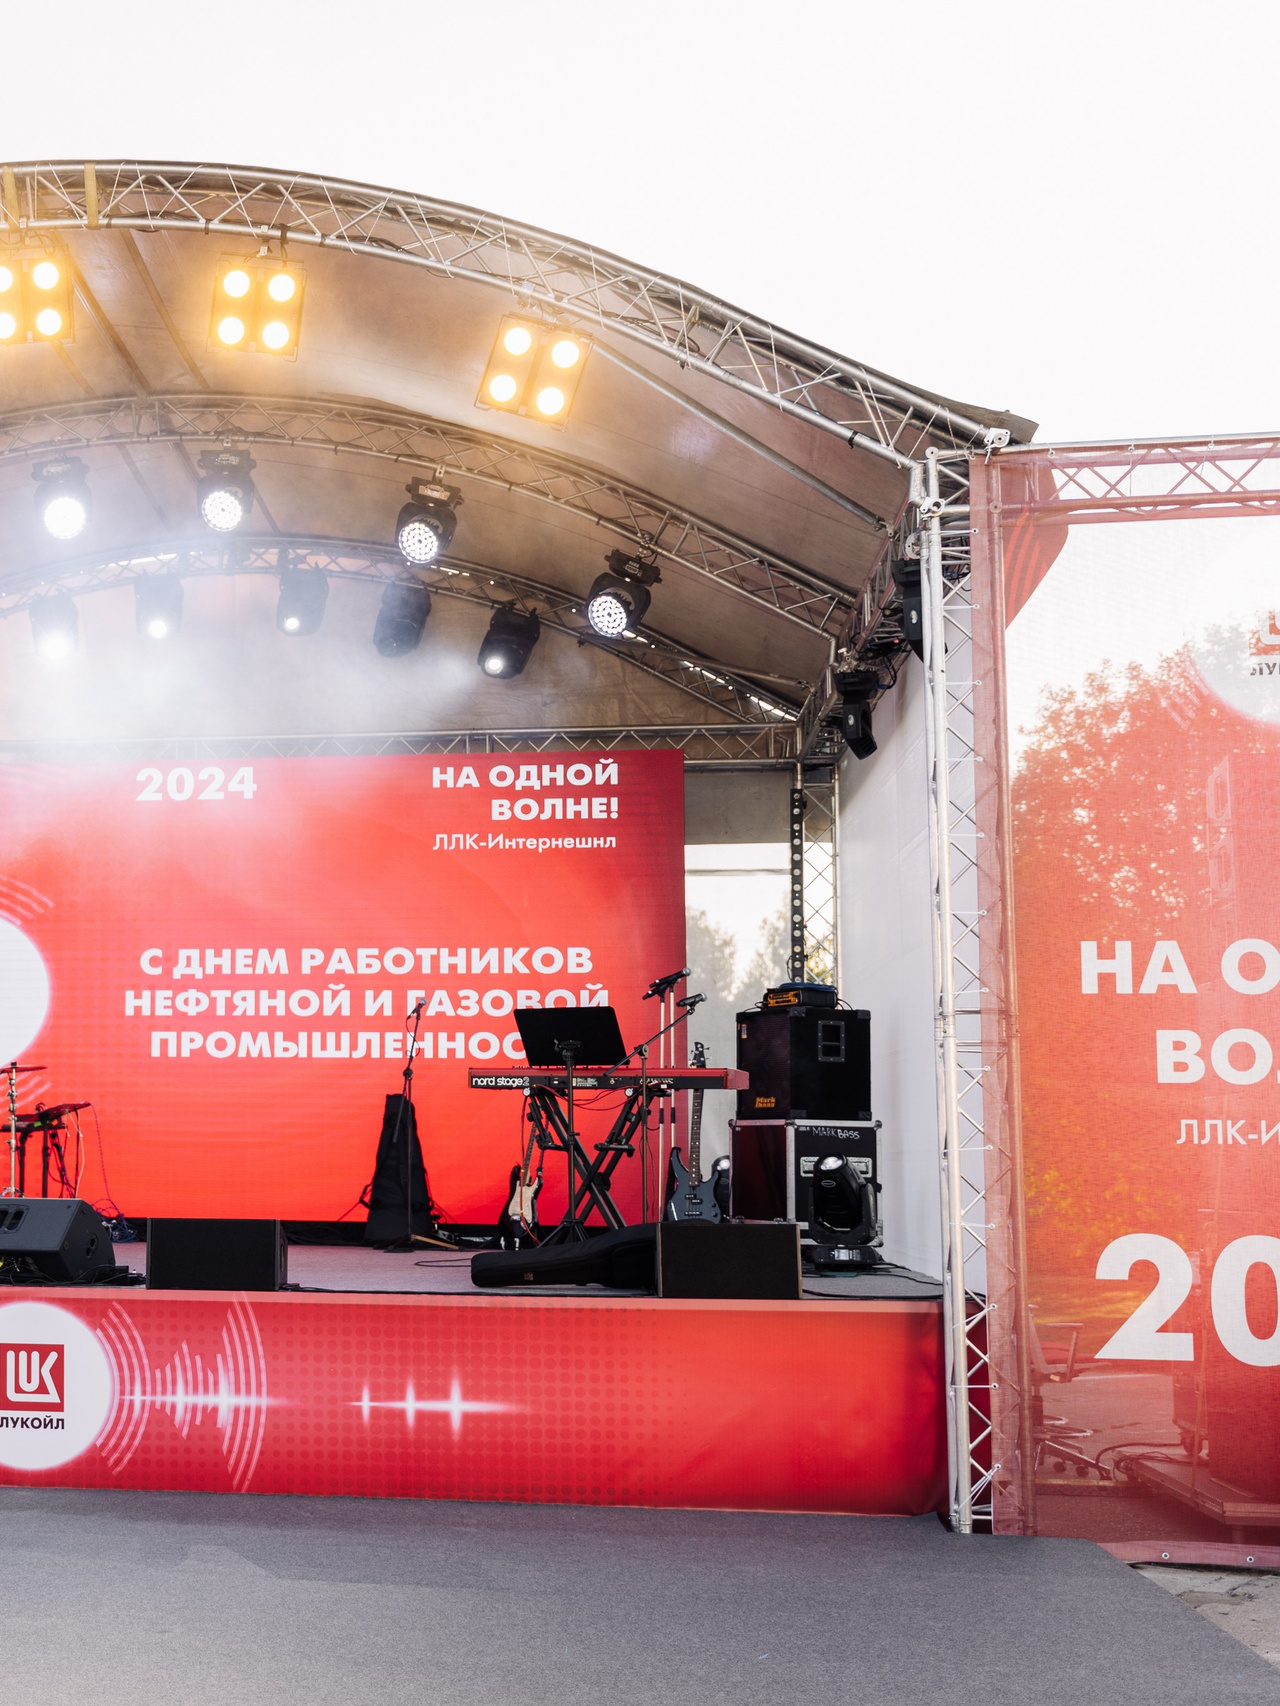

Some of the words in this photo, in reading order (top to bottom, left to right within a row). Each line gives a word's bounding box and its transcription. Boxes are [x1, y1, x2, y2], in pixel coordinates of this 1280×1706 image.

[1250, 662, 1280, 676] ЛУ
[135, 766, 257, 802] 2024
[432, 766, 480, 788] НА
[489, 759, 618, 791] ОДНОЙ
[491, 797, 618, 821] ВОЛНЕ!
[432, 833, 616, 853] ЛЛК-Интернешнл
[139, 948, 163, 976] С
[172, 948, 289, 980] ДНЕМ
[301, 947, 593, 975] РАБОТНИКОВ
[1080, 940, 1198, 994] НА
[125, 983, 351, 1017] НЕФТЯНОЙ
[364, 989, 393, 1016] И
[407, 983, 609, 1017] ГАЗОВОЙ
[1156, 1028, 1280, 1085] ВО
[472, 1076, 496, 1086] nord
[6, 1350, 61, 1403] LUK
